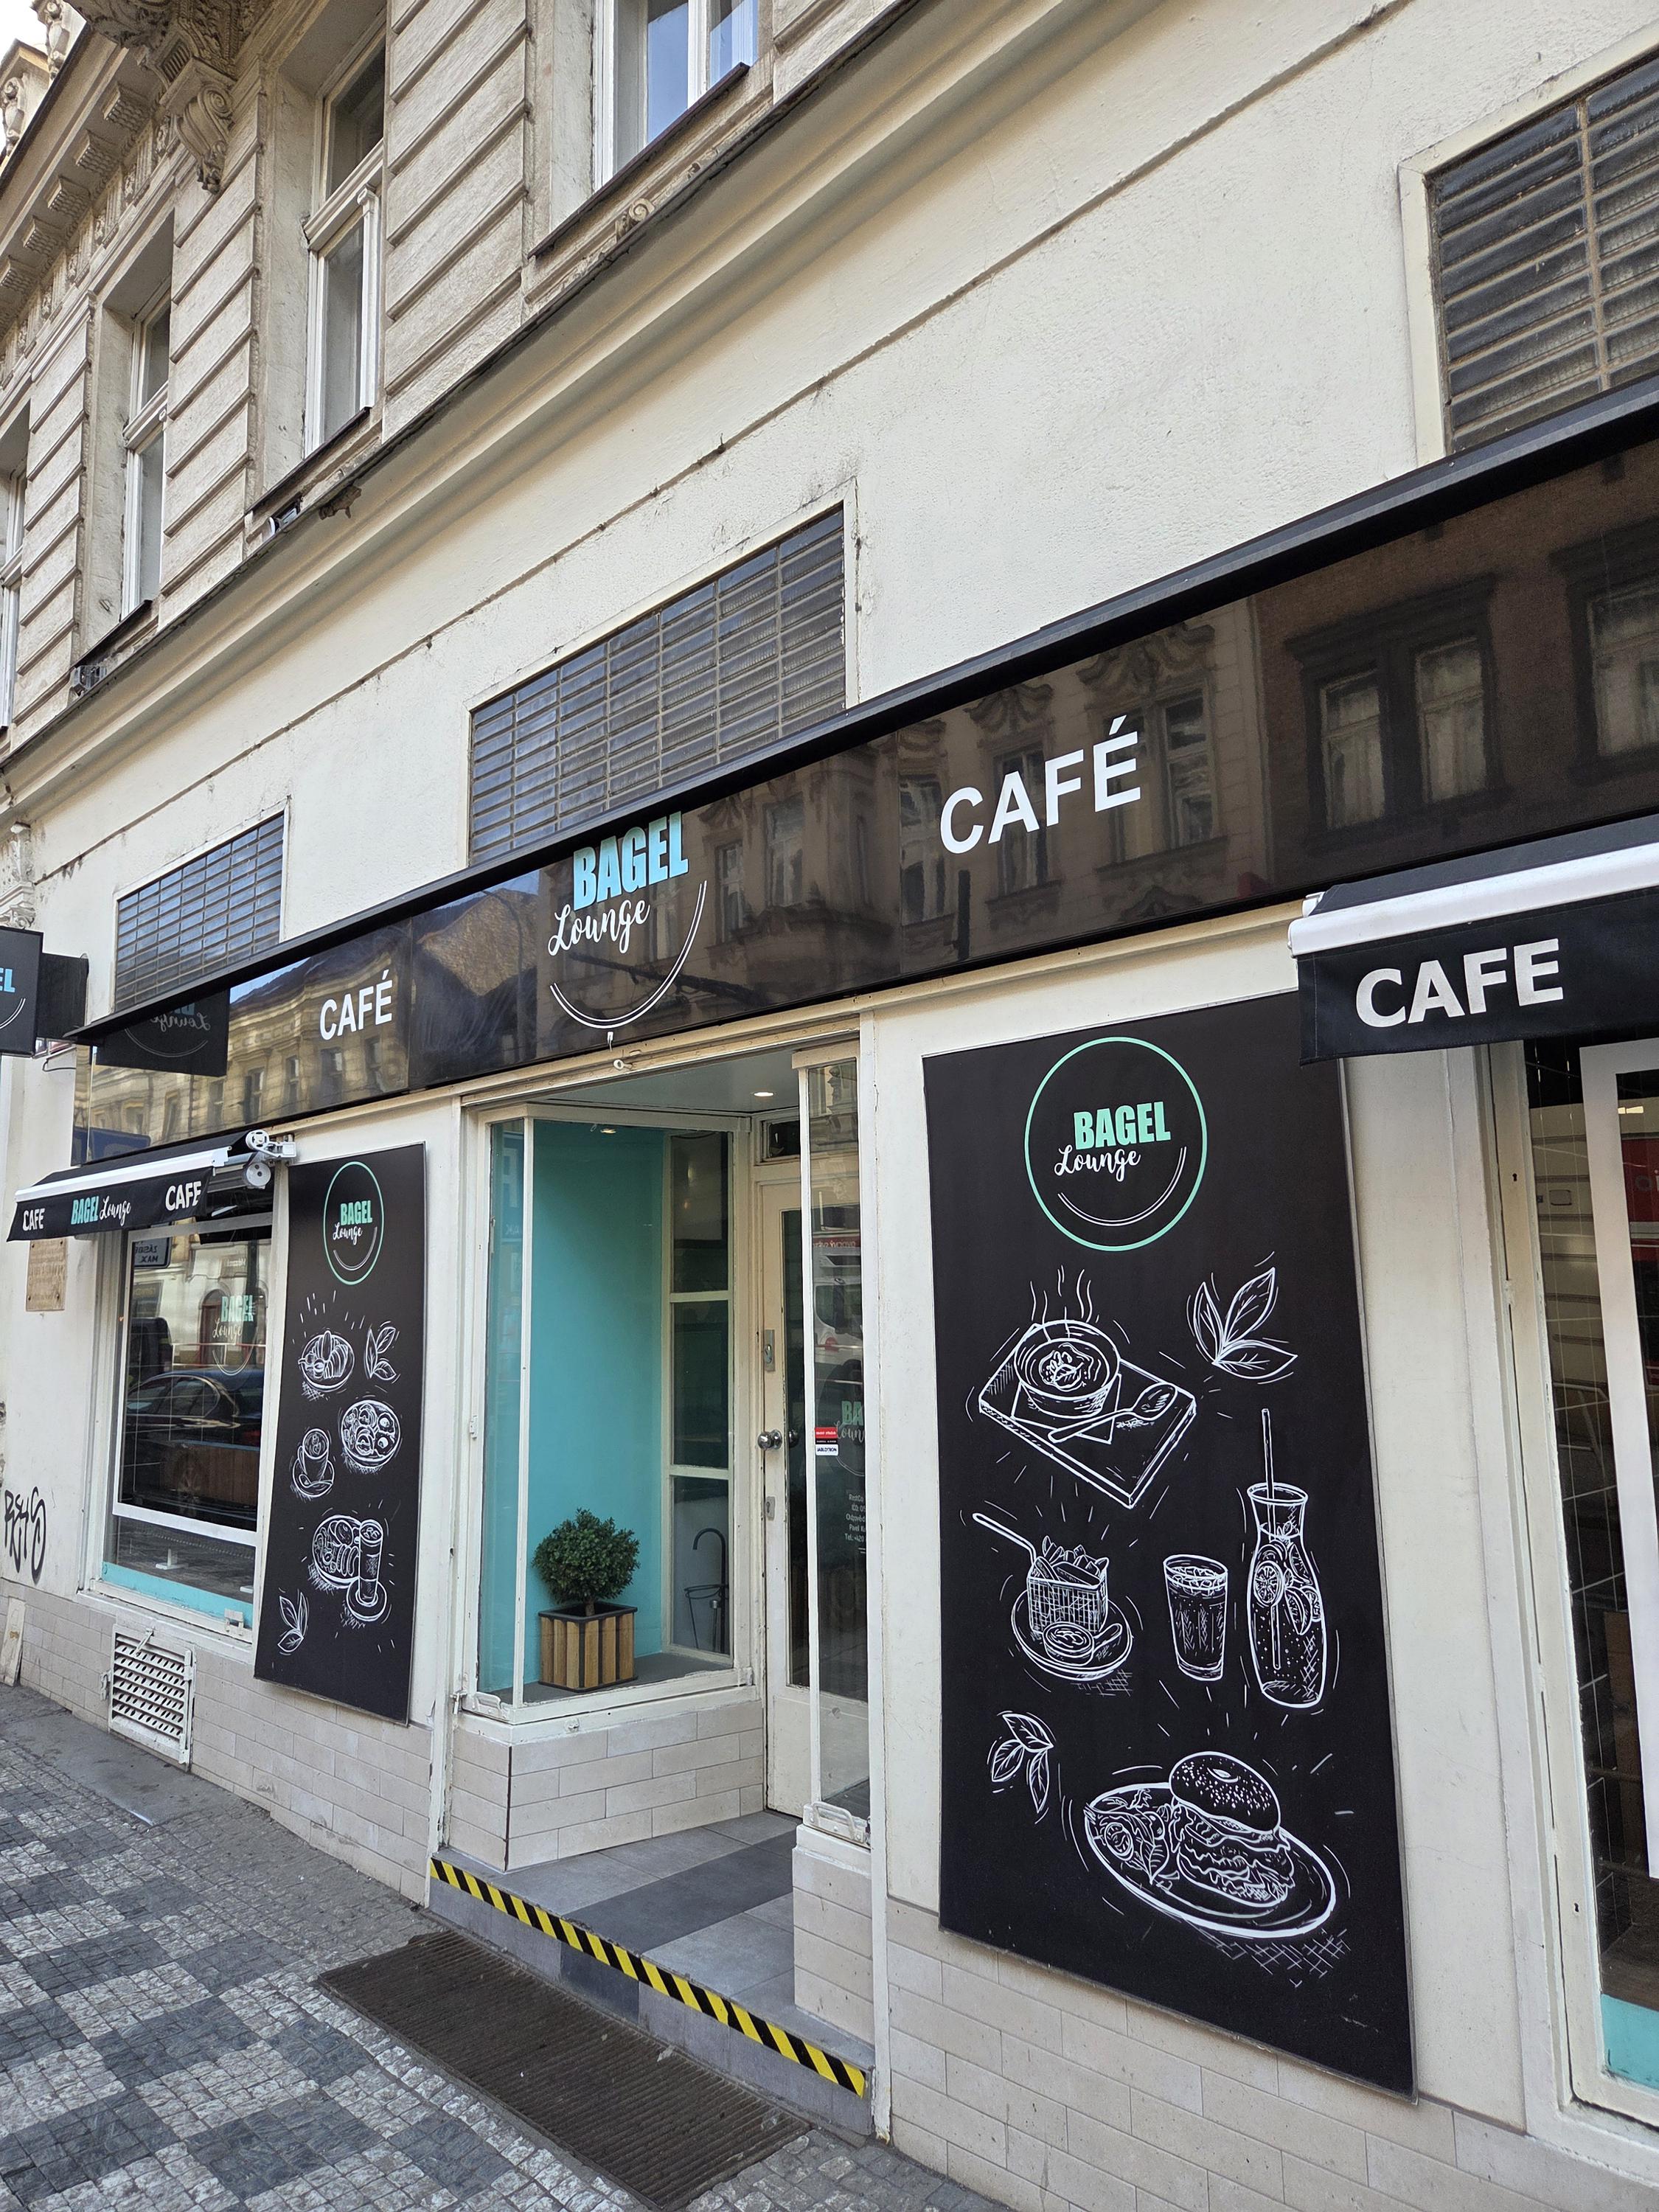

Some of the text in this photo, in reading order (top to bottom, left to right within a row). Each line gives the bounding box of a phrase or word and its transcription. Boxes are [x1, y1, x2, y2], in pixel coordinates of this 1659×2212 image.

[940, 714, 1141, 854] CAFÉ
[573, 811, 689, 911] BAGEL
[548, 898, 650, 956] Lounge
[319, 969, 393, 1040] CAFÉ
[1355, 938, 1564, 1028] CAFE
[1074, 1101, 1172, 1150] BAGEL
[1054, 1144, 1141, 1182] Lounge
[22, 1180, 202, 1231] CAFE BAGEL Lounge CAFE
[341, 1200, 373, 1226] BAGEL
[333, 1222, 363, 1245] Lounge
[221, 1295, 254, 1322] BAGEL
